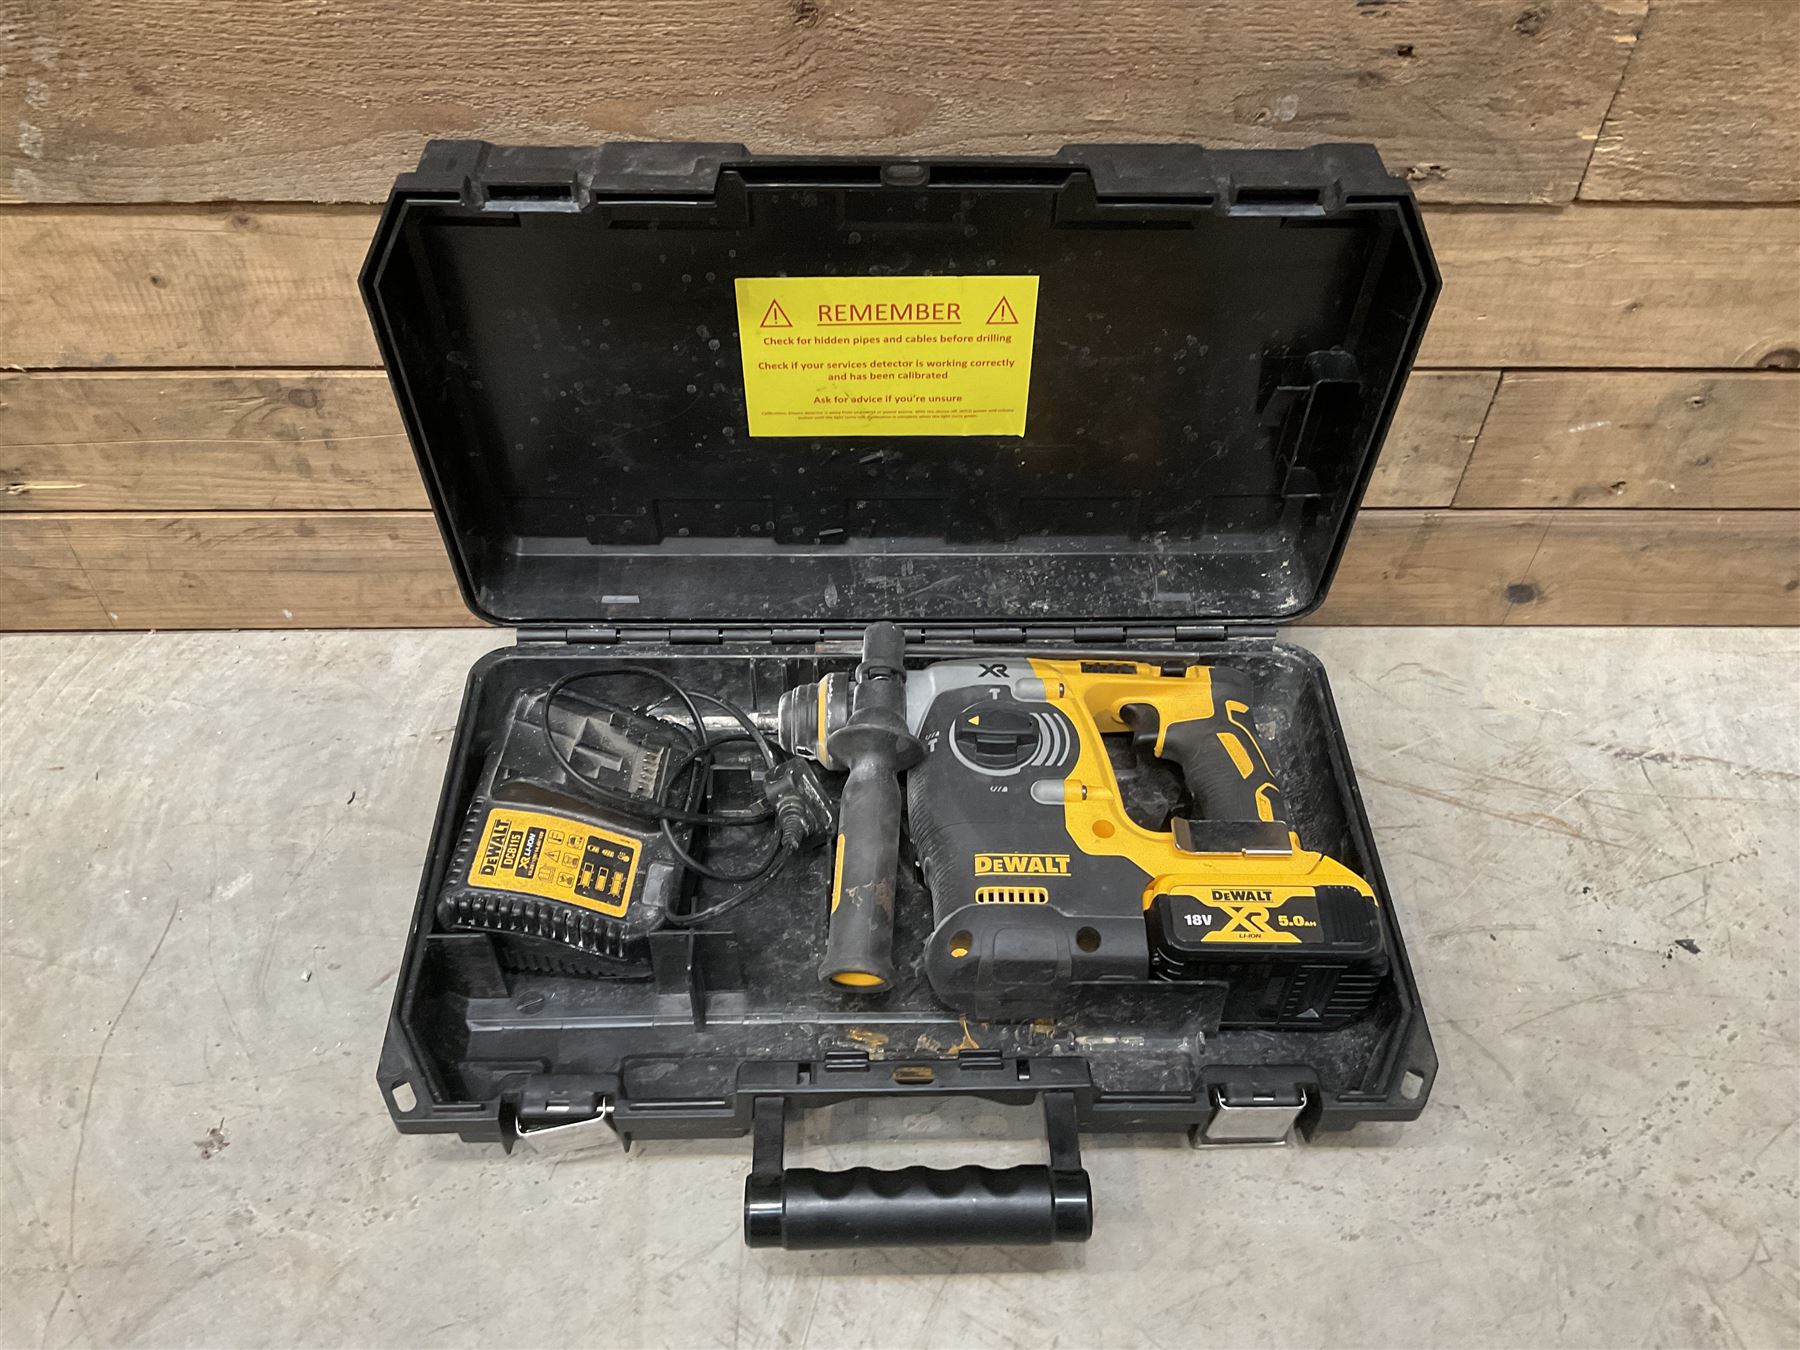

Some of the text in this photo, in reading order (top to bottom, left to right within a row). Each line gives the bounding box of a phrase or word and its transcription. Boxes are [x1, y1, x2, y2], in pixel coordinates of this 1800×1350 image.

[818, 303, 961, 322] REMEMBER
[763, 334, 1012, 346] Check for hidden pipes and cables before drilling
[758, 358, 1015, 371] Check if your services detector is working correctly
[828, 371, 949, 381] and has been calibrated
[813, 394, 963, 404] Ask for advice if you're unsure
[978, 663, 1010, 678] XR
[504, 833, 521, 866] DCB115
[1184, 914, 1212, 926] 18V
[1221, 906, 1276, 933] XR
